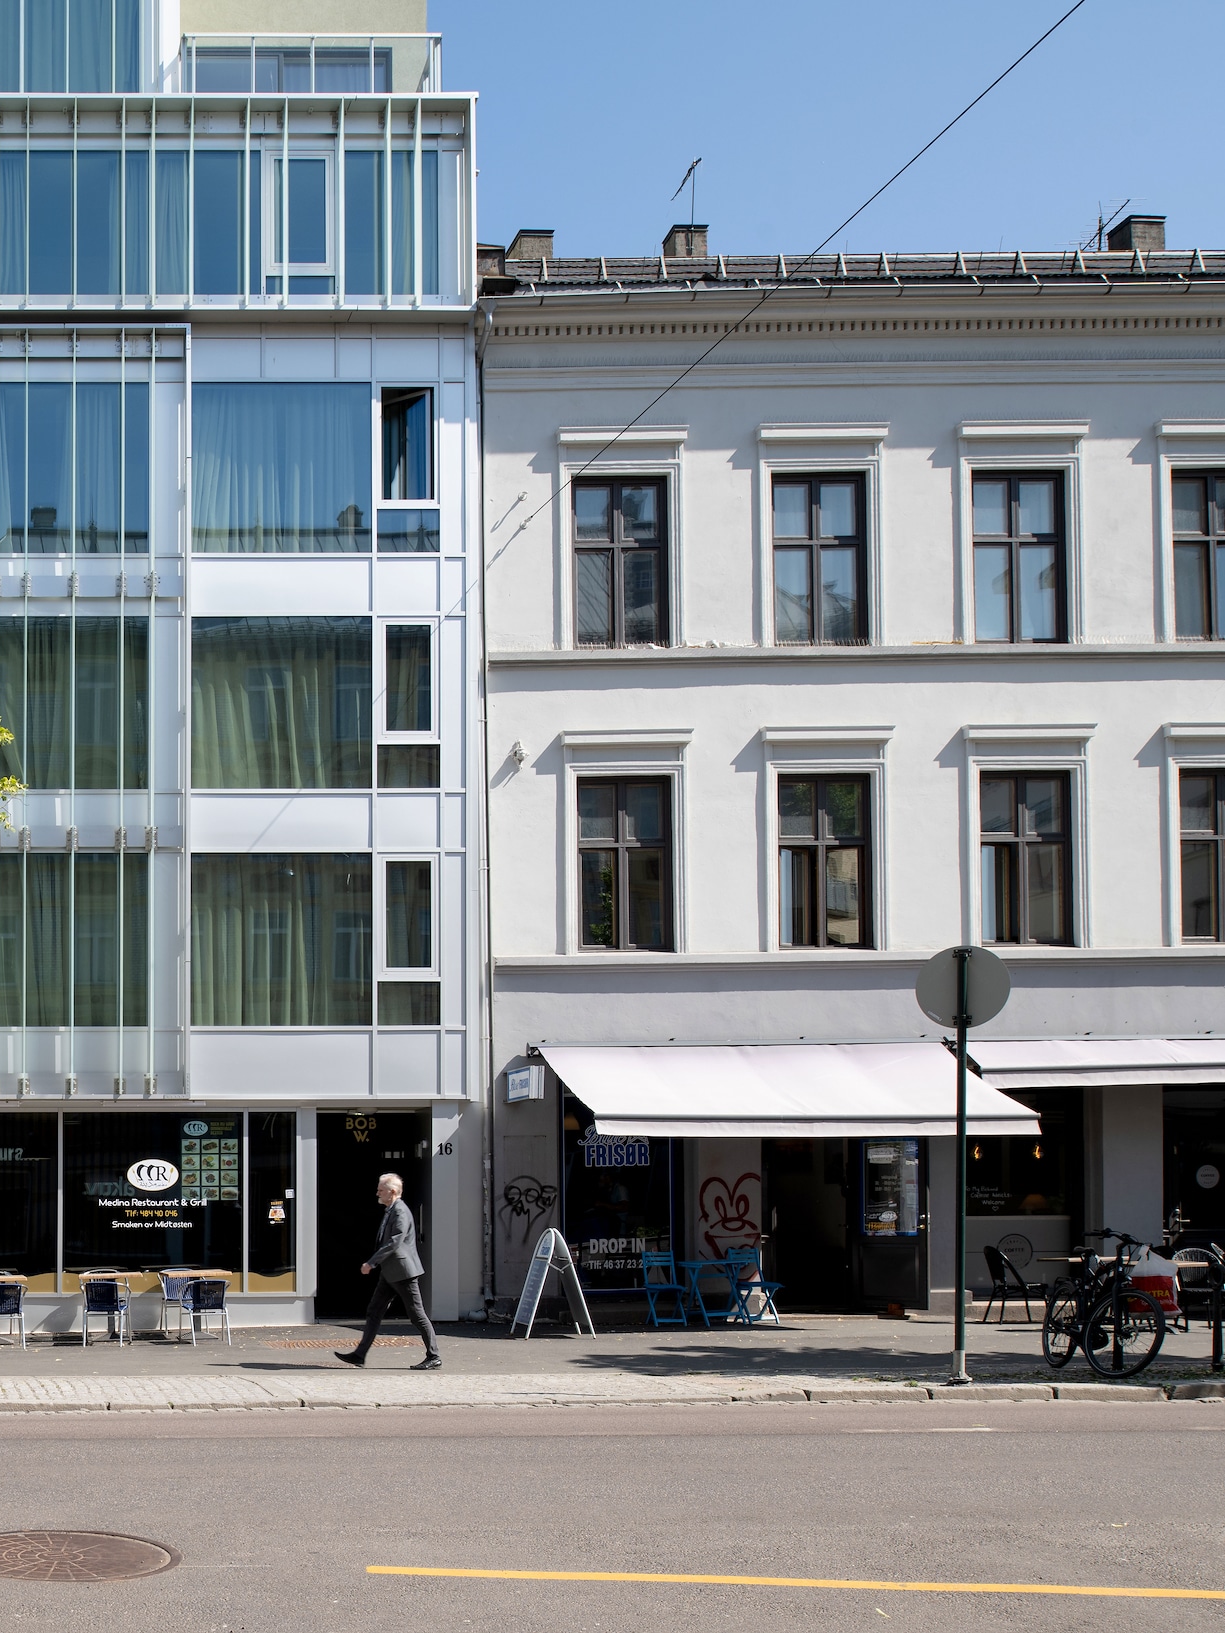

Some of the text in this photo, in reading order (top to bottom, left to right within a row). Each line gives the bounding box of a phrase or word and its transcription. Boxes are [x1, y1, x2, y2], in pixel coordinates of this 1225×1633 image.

[346, 1117, 376, 1129] BOB
[353, 1130, 370, 1142] W.
[437, 1142, 453, 1155] 16
[585, 1143, 650, 1167] FRISØR
[98, 1198, 208, 1207] Medina Restaurant & Grill
[124, 1209, 178, 1217] Tlf: 484 40 046
[111, 1221, 143, 1229] Smaken
[589, 1238, 646, 1254] DROP IN
[588, 1259, 648, 1269] Tlf: 46 37 23 2
